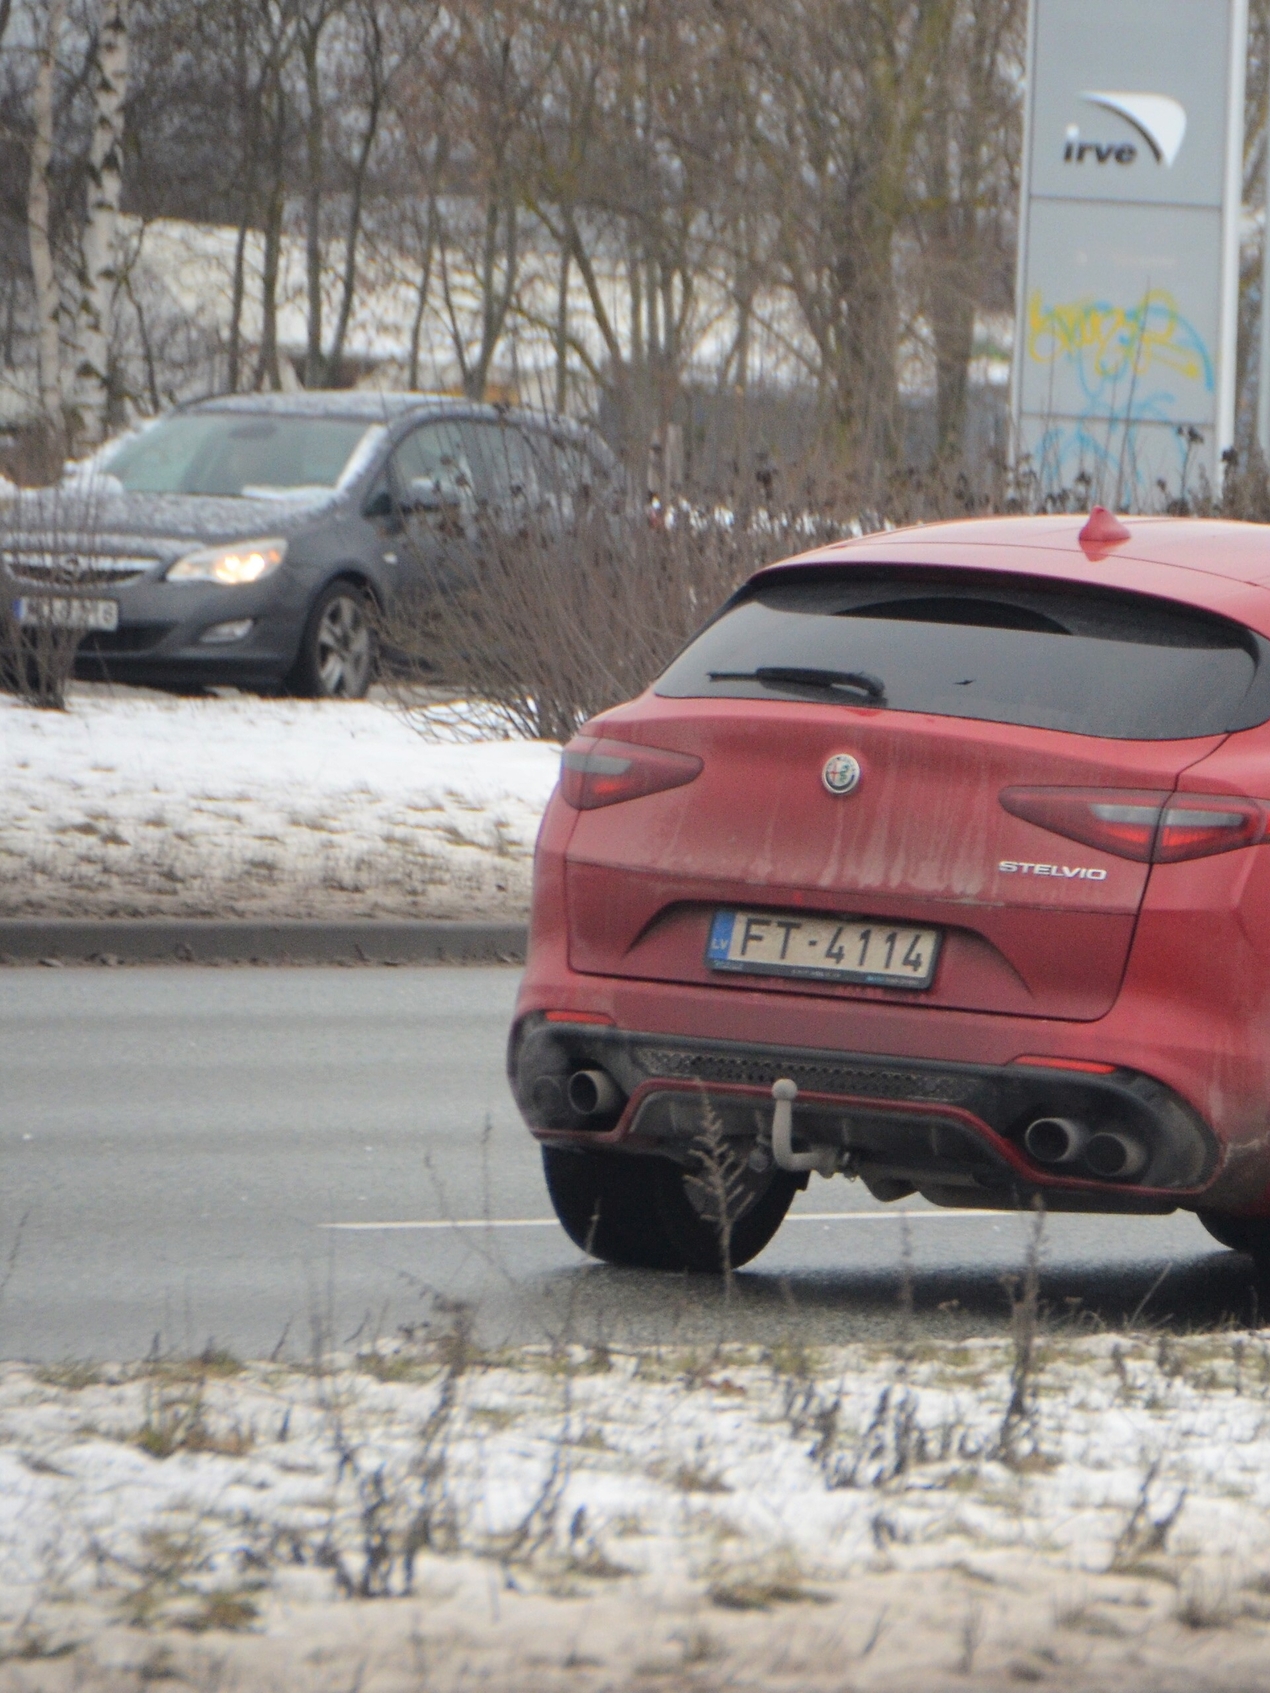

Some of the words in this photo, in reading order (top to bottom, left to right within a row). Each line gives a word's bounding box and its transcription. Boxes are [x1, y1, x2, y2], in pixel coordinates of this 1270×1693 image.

[1064, 123, 1138, 163] irve
[999, 860, 1107, 880] STELVIO
[740, 918, 922, 972] FT-4114
